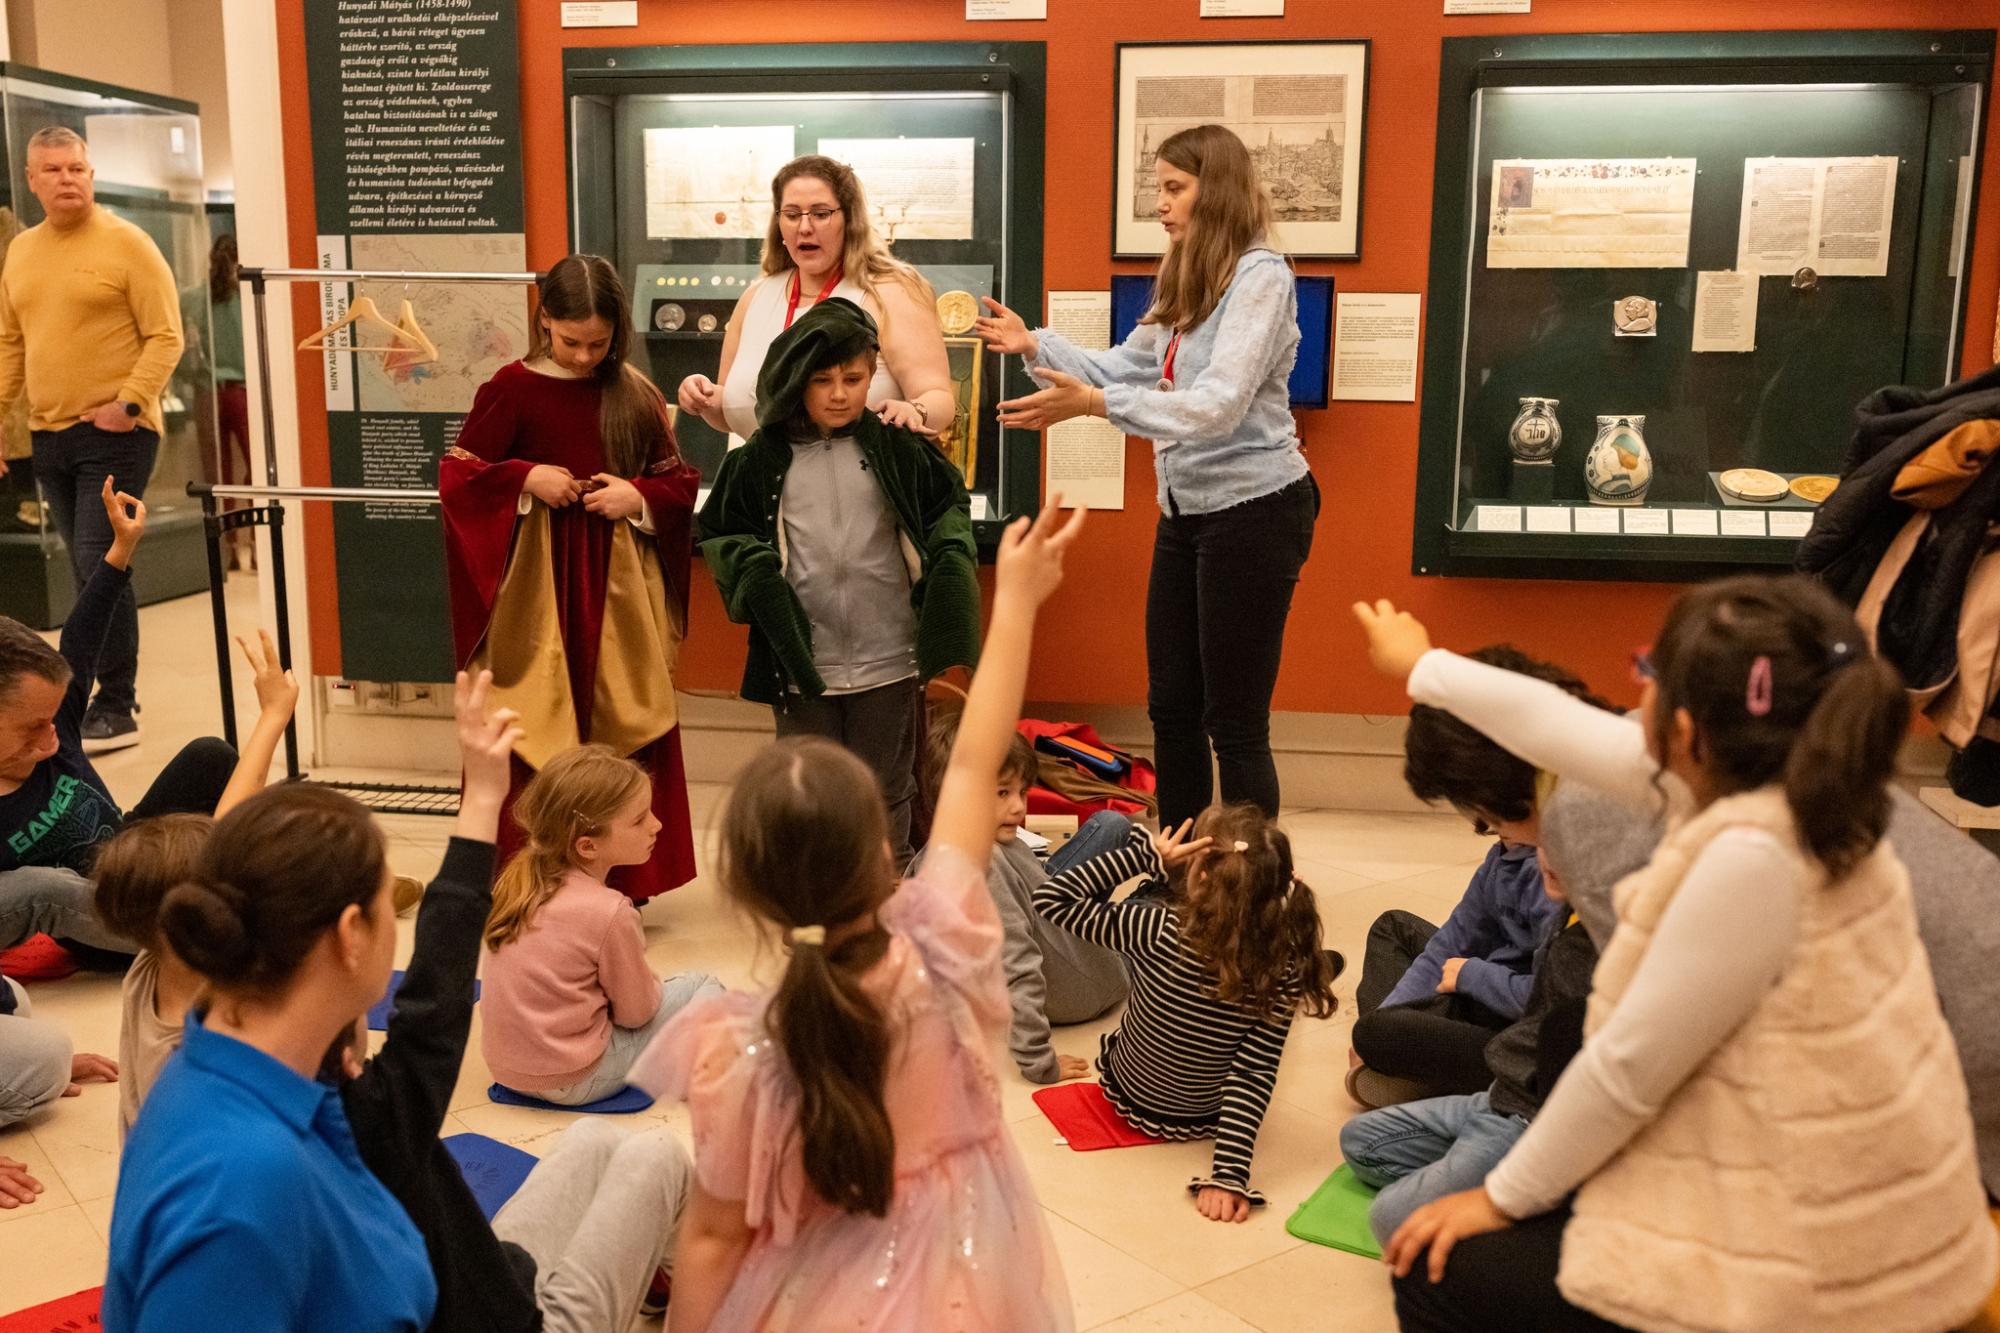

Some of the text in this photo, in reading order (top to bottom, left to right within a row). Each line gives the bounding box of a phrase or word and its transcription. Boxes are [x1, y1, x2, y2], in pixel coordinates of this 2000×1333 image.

[338, 0, 376, 12] Hunyadi
[380, 0, 412, 11] Mátyás
[367, 124, 416, 132] Humanista
[8, 774, 79, 853] GAMER
